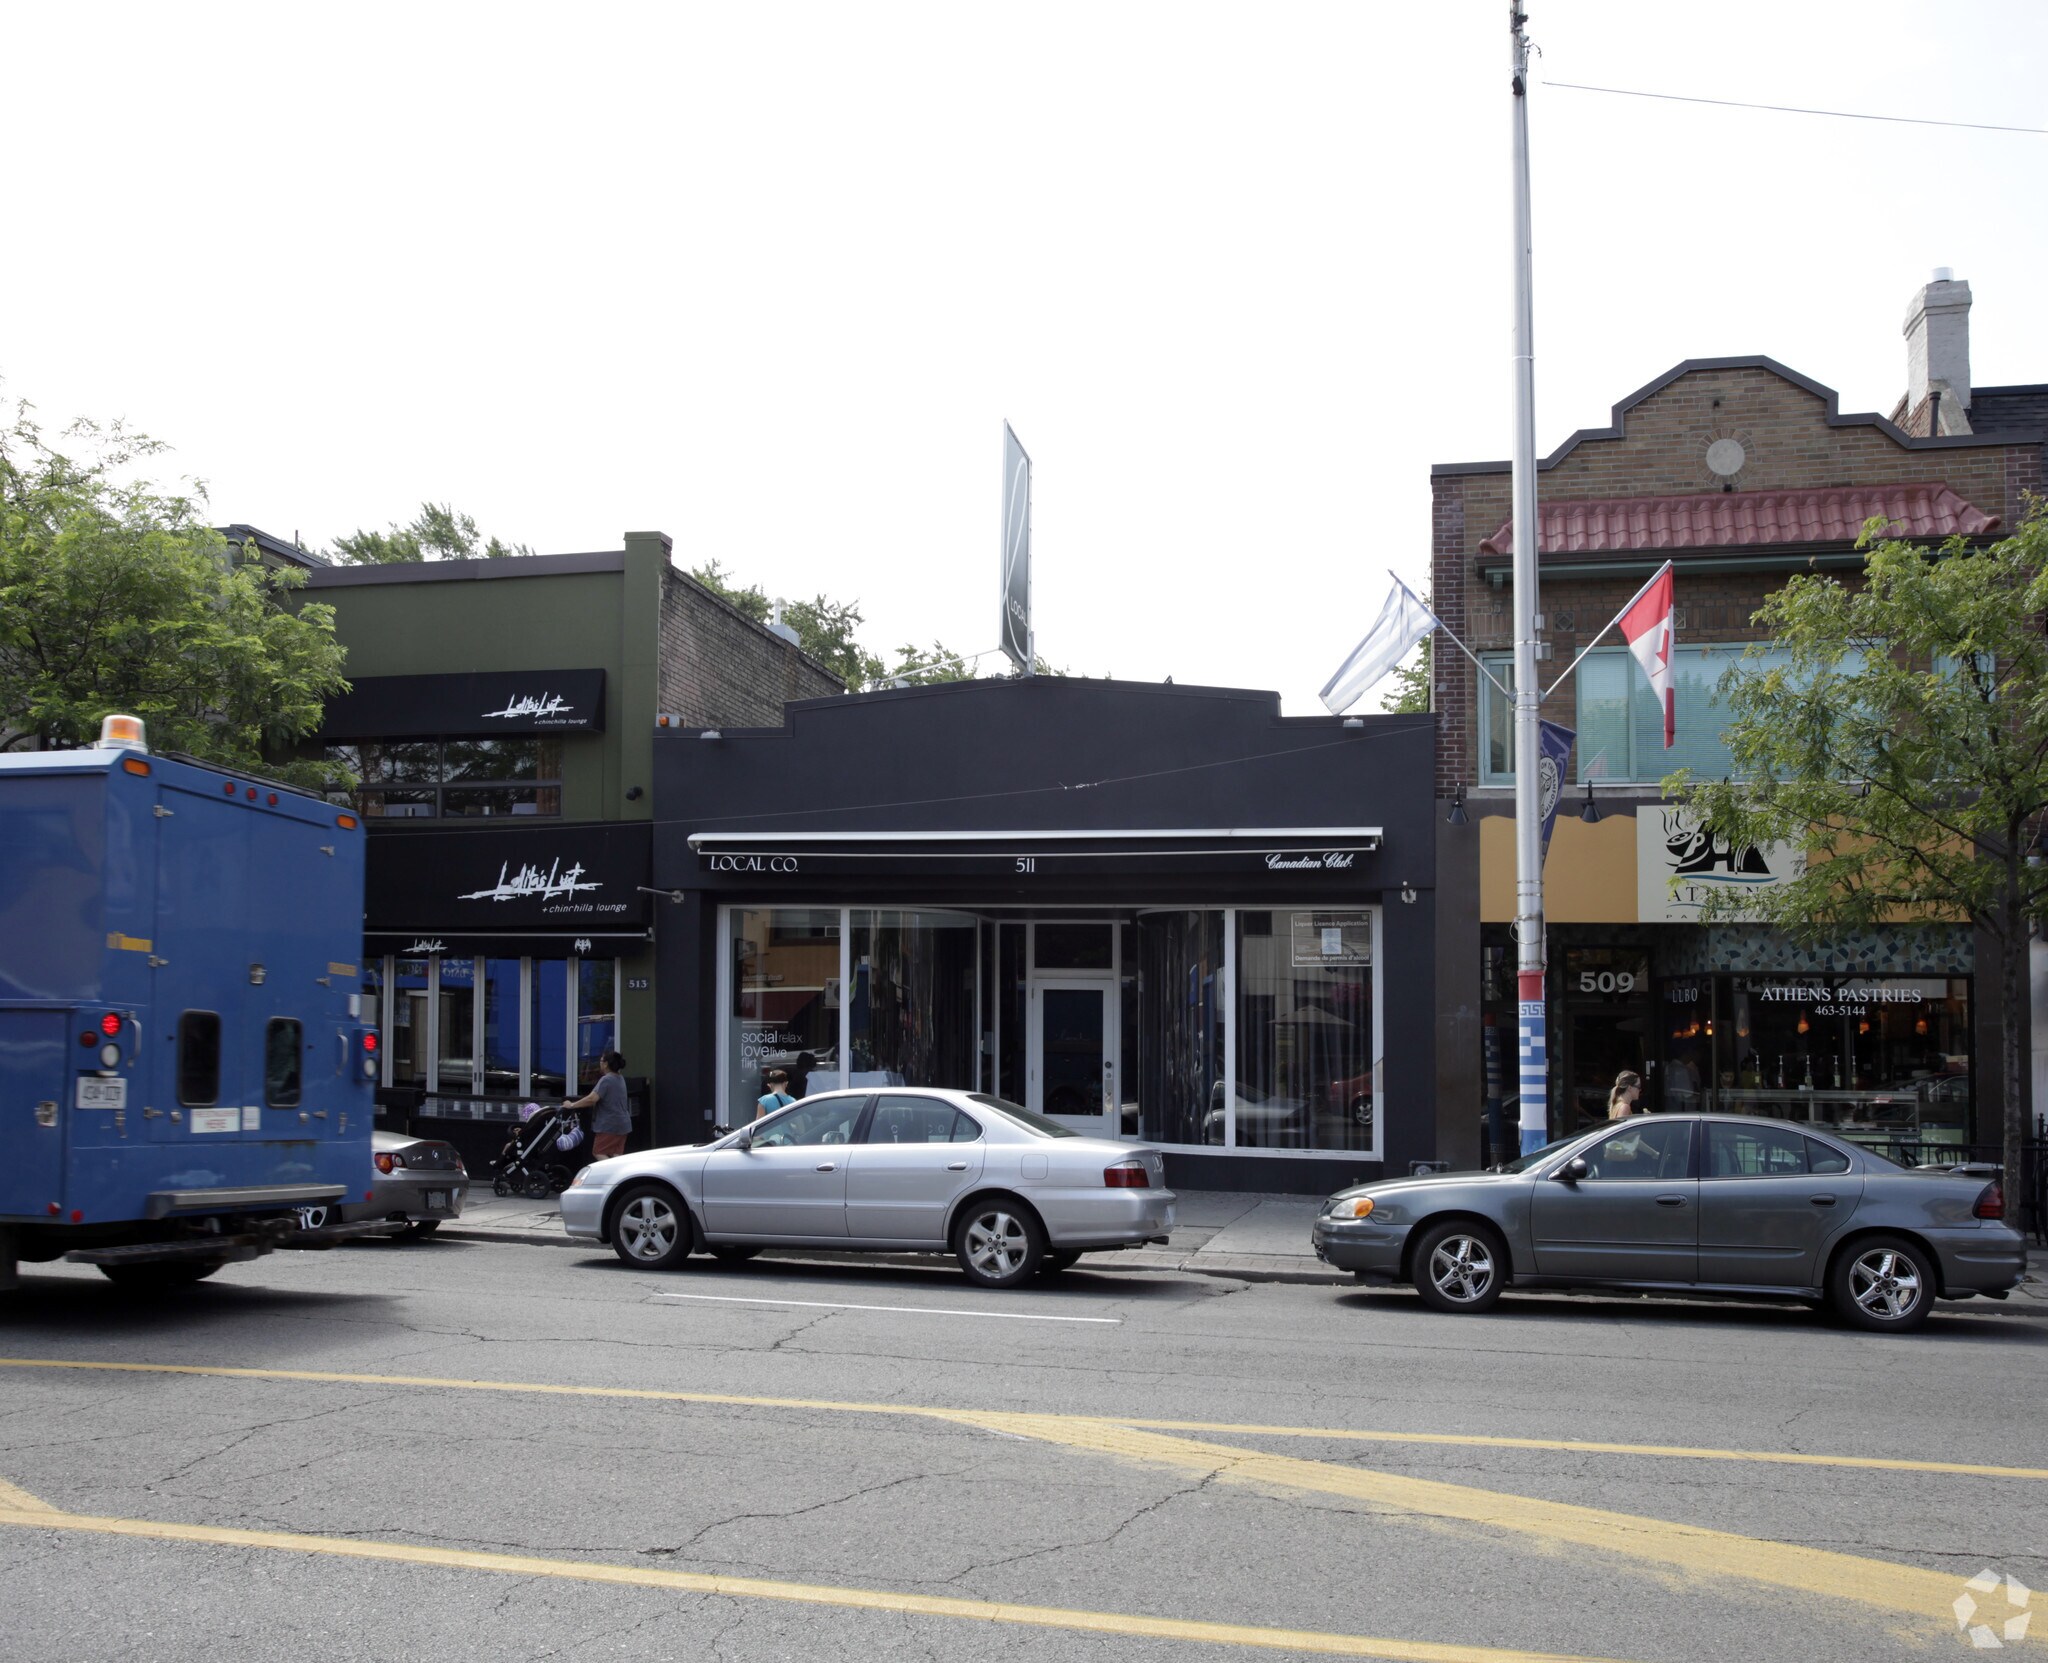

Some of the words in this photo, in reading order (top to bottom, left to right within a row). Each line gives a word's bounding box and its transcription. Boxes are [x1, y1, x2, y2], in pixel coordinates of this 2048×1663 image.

[1010, 596, 1028, 627] LOCAL
[711, 855, 766, 871] LOCAL
[770, 856, 799, 872] CO.
[1015, 857, 1035, 873] 511
[1265, 853, 1322, 869] Canadian
[549, 904, 593, 913] chinchilla
[596, 903, 627, 912] lounge
[628, 979, 648, 988] 513
[1580, 971, 1635, 993] 509
[1760, 987, 1832, 1002] ATHENS
[1837, 988, 1922, 1003] PASTRIES
[1814, 1005, 1866, 1016] 463-5144
[741, 1030, 778, 1043] social
[741, 1043, 770, 1058] love
[741, 1057, 757, 1069] flirt
